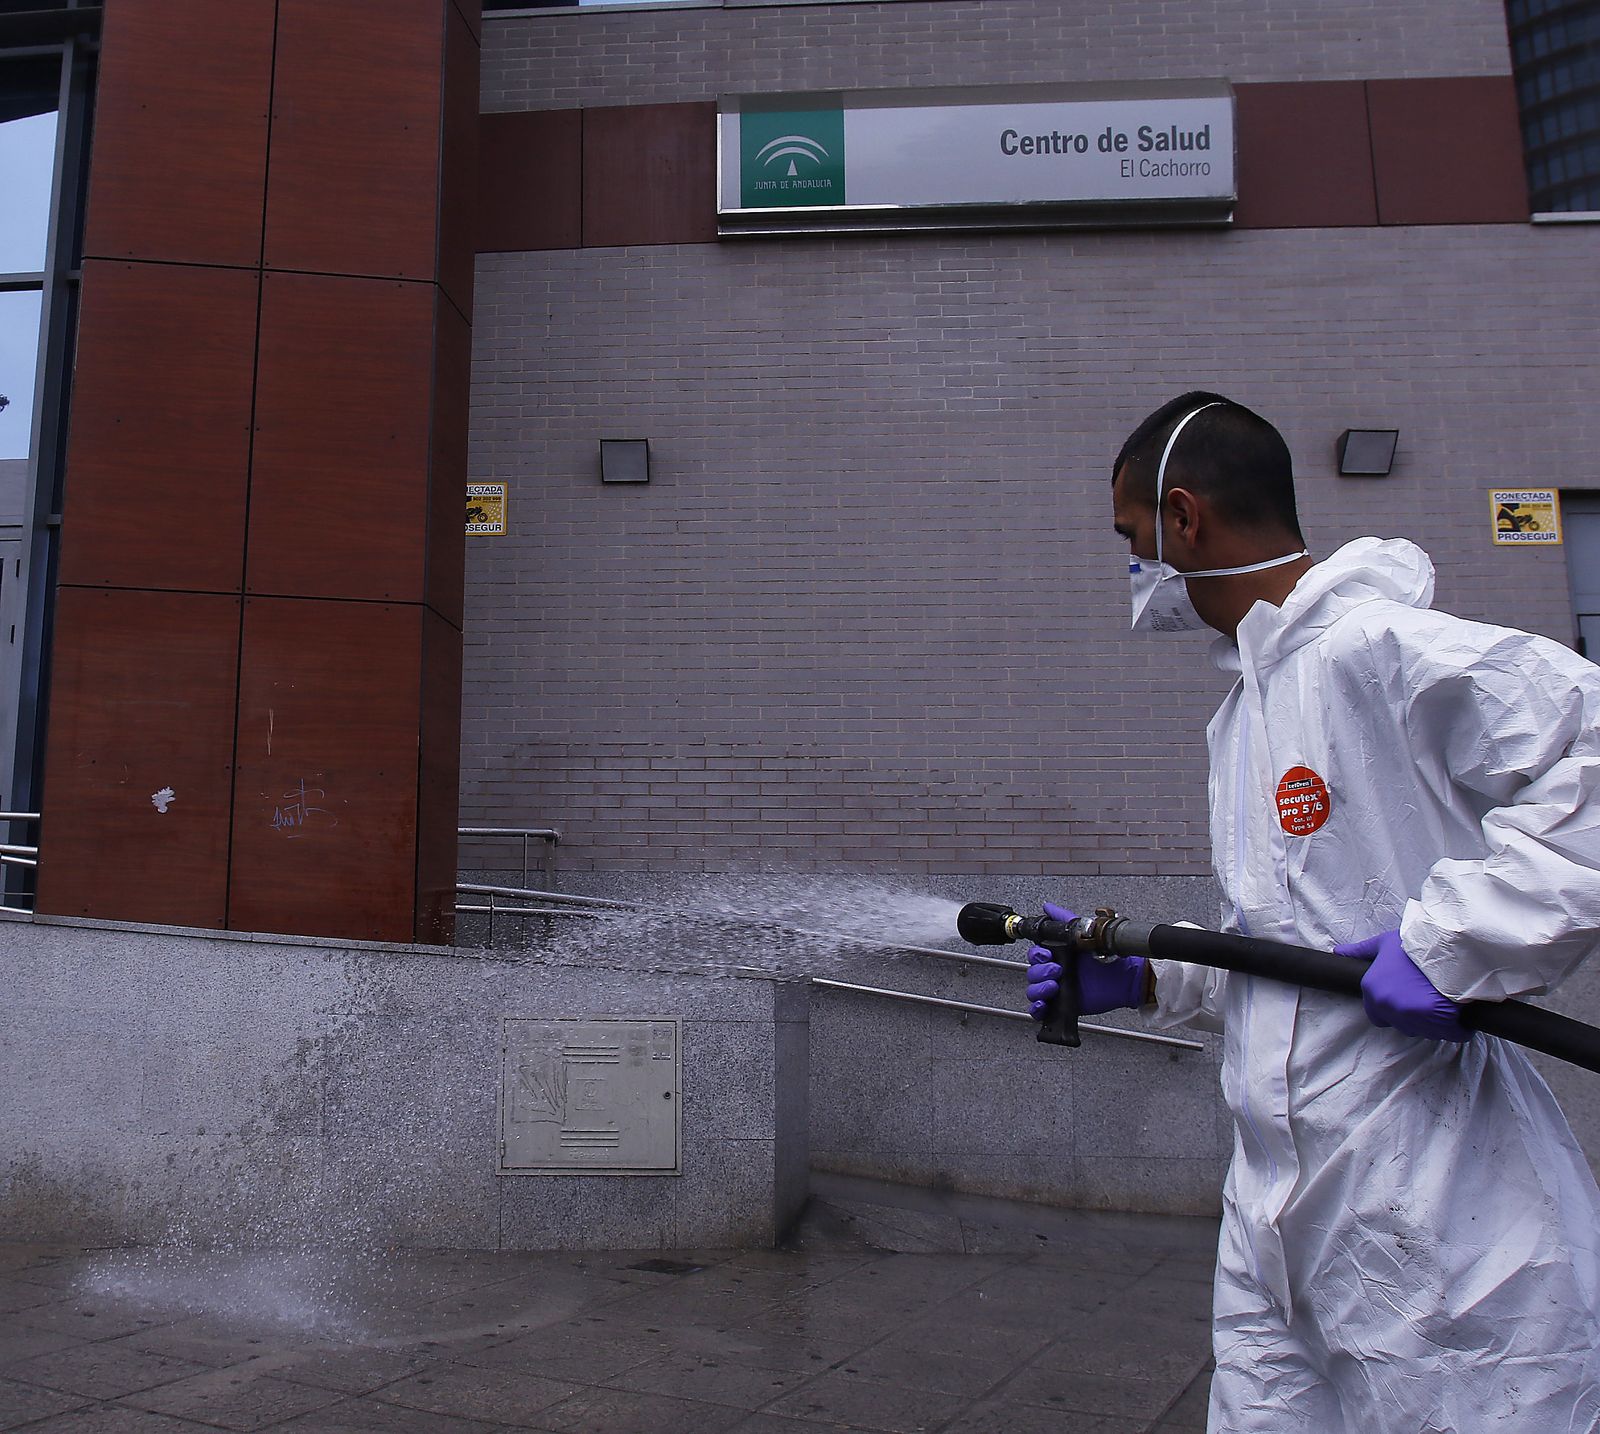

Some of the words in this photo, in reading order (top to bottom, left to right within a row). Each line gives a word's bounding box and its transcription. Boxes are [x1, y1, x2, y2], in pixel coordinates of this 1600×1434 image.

[1000, 129, 1089, 155] Centro
[1097, 126, 1129, 152] de
[1137, 124, 1210, 151] Salud
[1120, 159, 1134, 178] El
[1139, 158, 1211, 178] Cachorro
[753, 181, 777, 190] JUNTA
[780, 180, 789, 189] DE
[1497, 532, 1557, 541] PROSEGUR
[1281, 808, 1299, 819] pro
